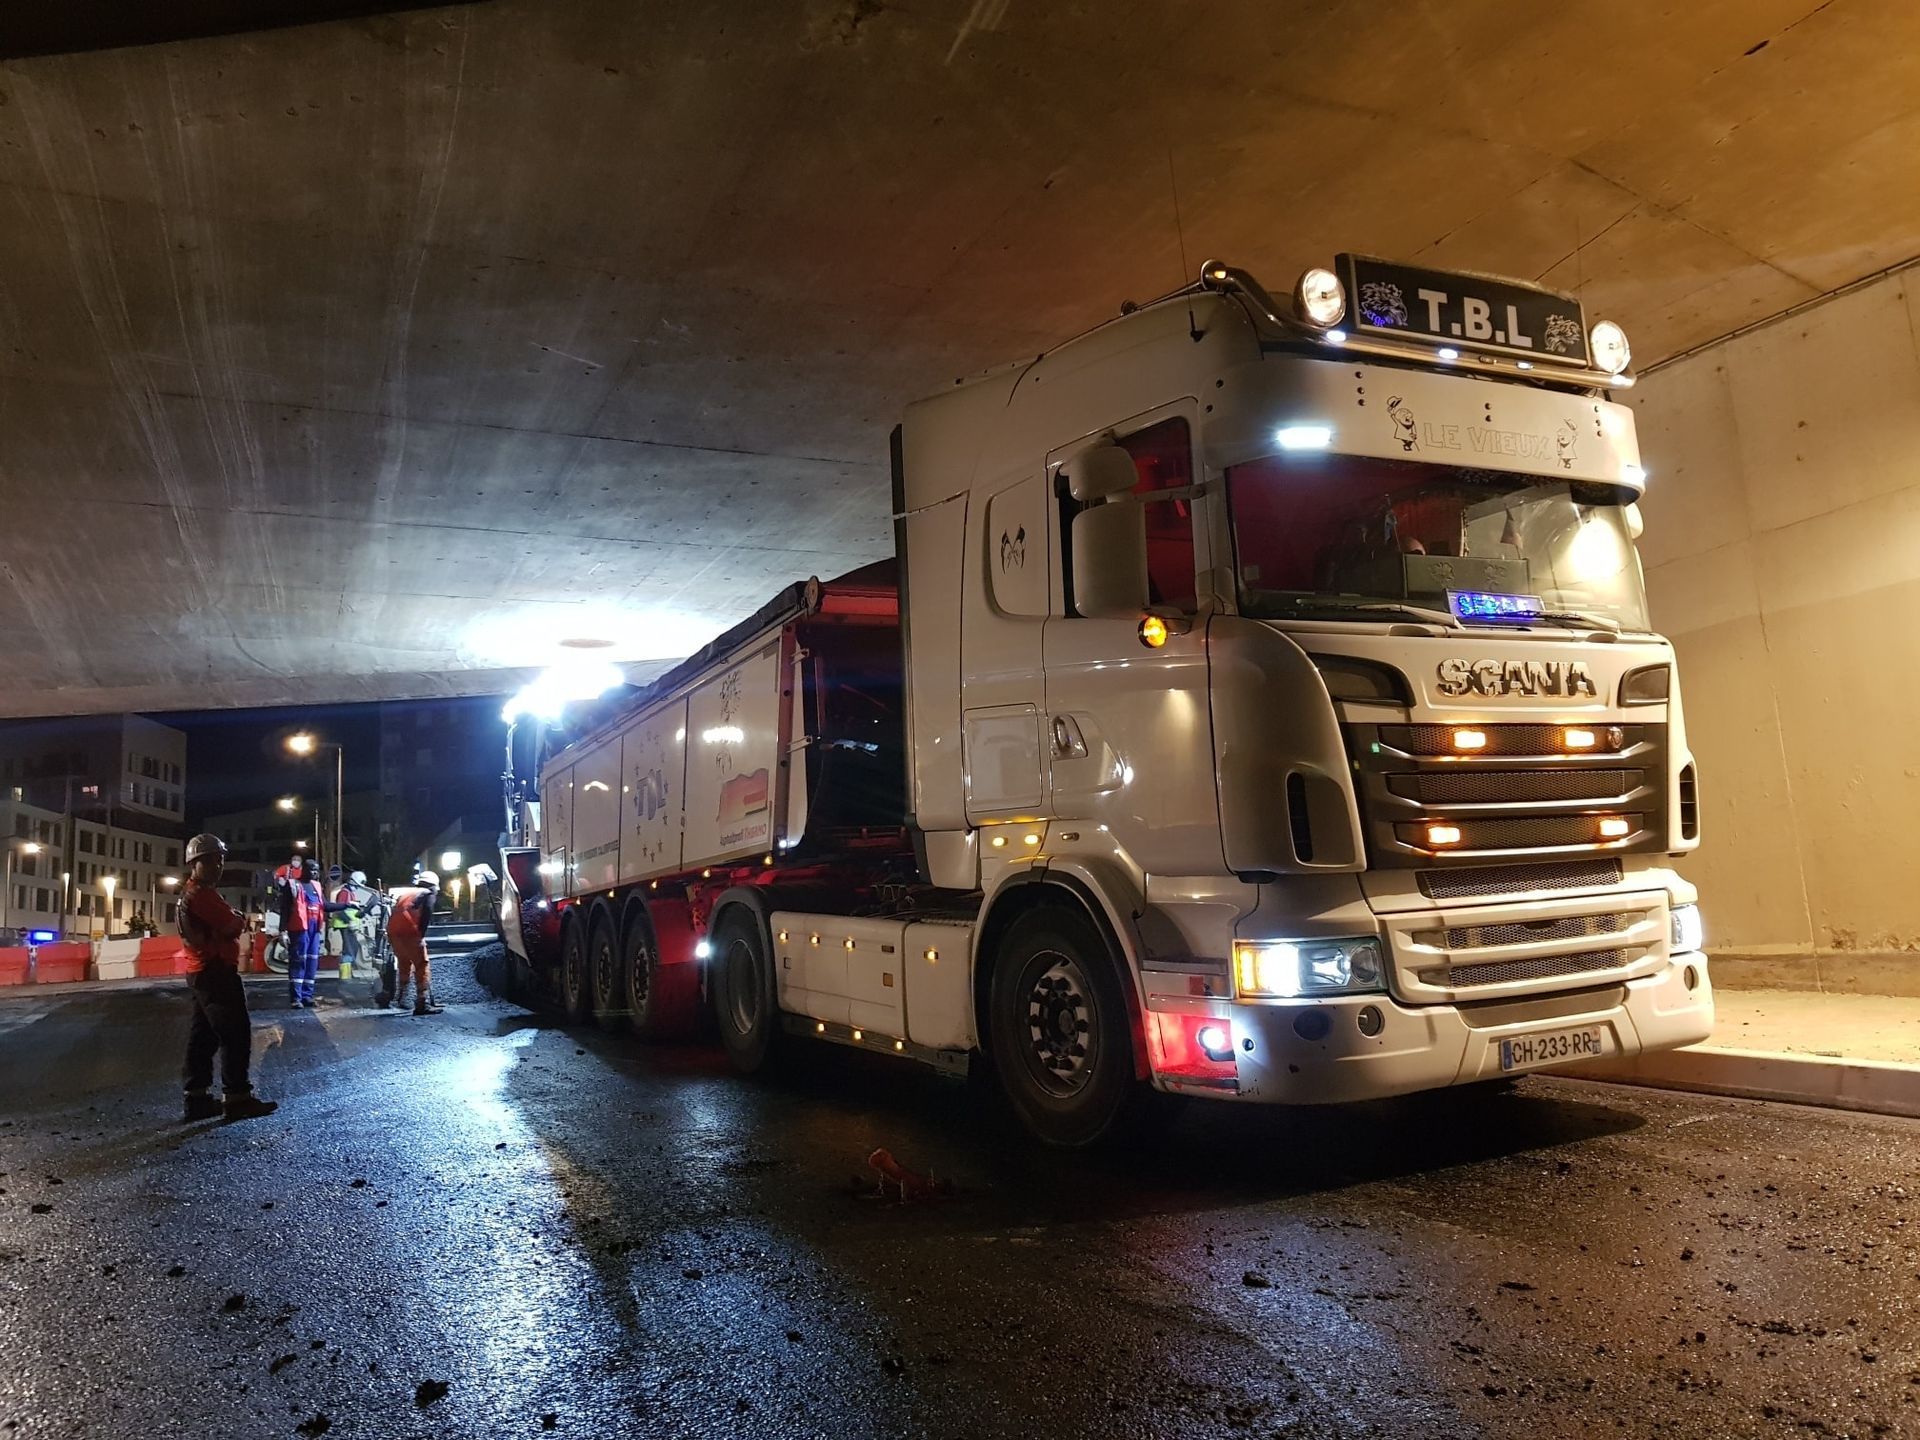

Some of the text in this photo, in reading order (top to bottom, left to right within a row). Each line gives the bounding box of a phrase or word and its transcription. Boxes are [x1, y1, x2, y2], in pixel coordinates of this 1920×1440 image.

[1418, 288, 1532, 348] T.B.L
[1423, 422, 1553, 460] LE VIEUX
[1437, 658, 1597, 697] SCANIA
[1511, 1032, 1592, 1063] CH-233-RR
